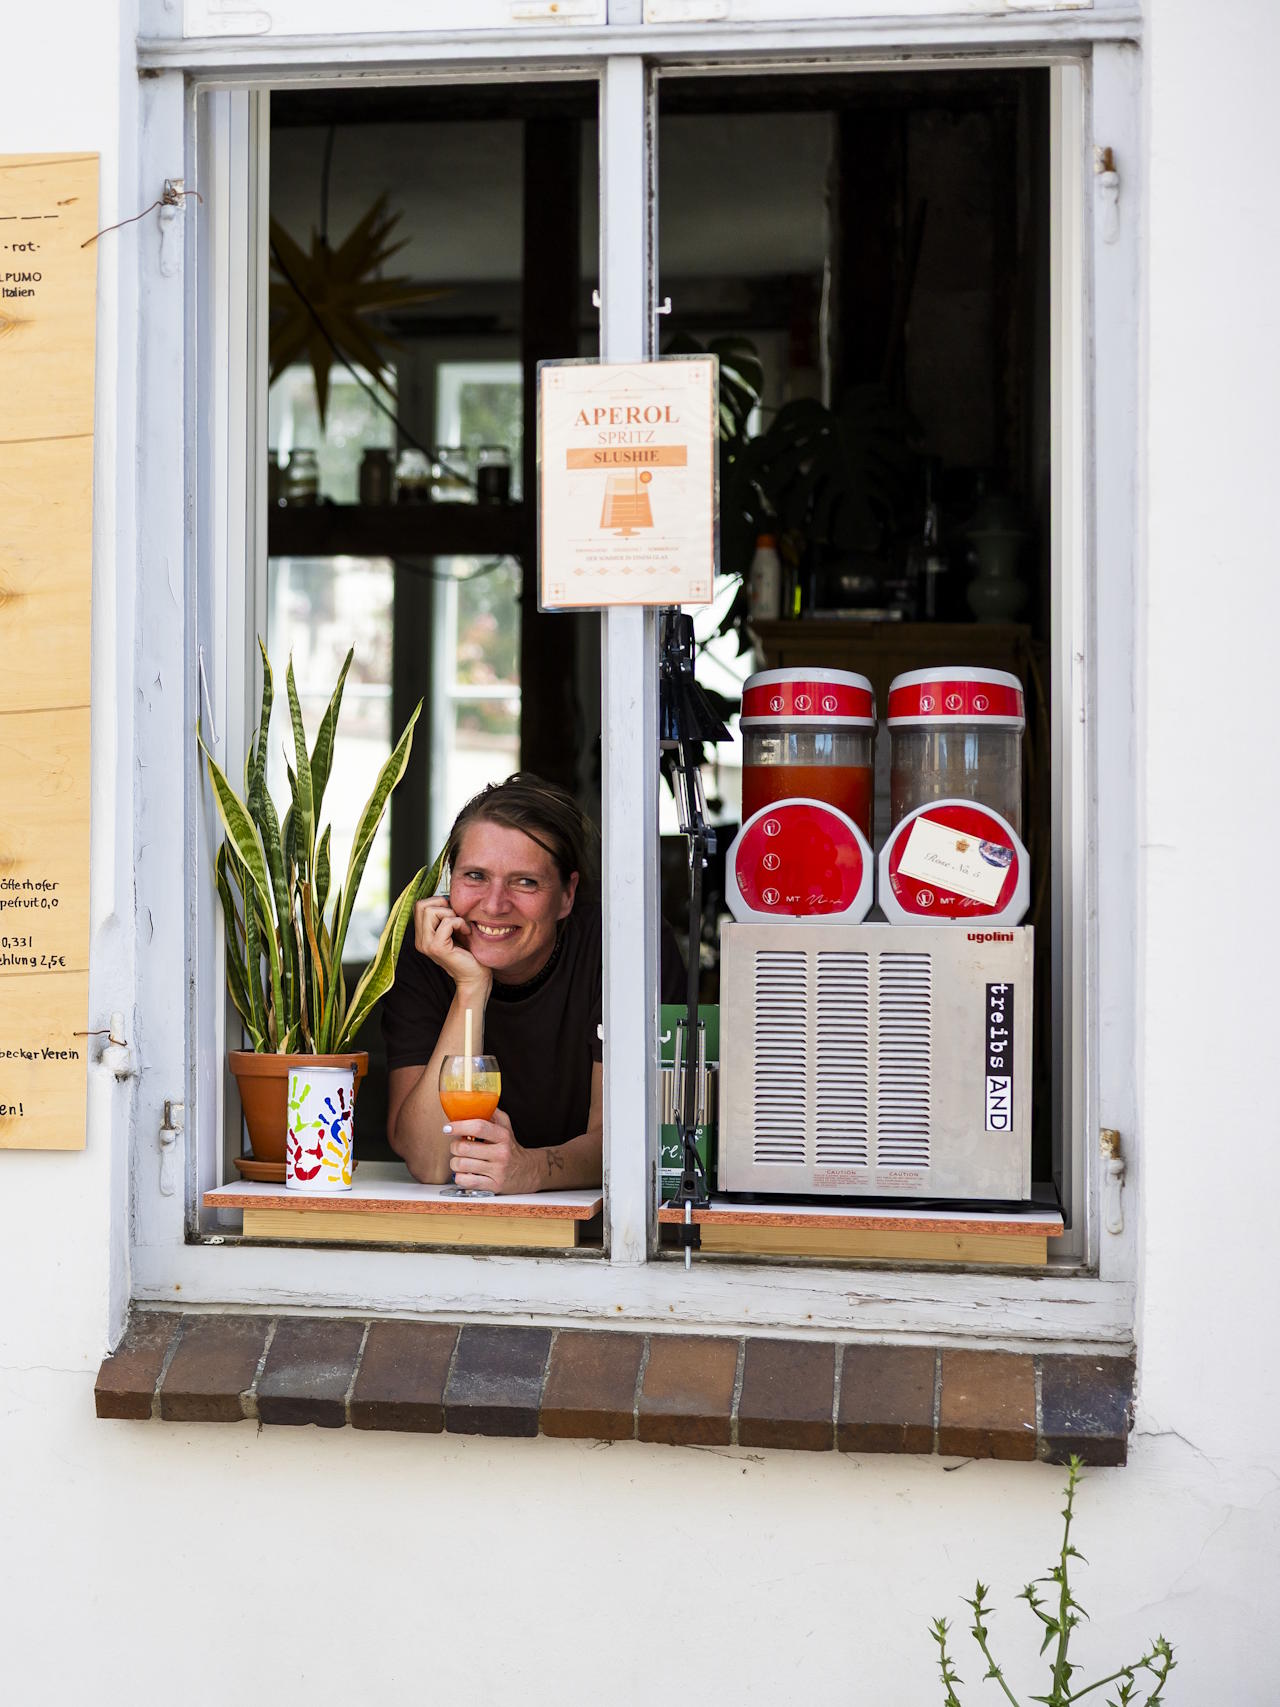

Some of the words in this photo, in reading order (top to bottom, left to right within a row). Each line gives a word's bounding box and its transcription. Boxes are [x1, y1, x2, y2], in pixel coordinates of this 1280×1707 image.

[3, 271, 42, 283] PUMO
[2, 287, 35, 299] Italien
[574, 405, 680, 426] APEROL
[598, 430, 655, 444] SPRITZ
[593, 450, 660, 463] SLUSHIE
[40, 897, 59, 910] 0,0
[967, 932, 1014, 943] ugolini
[40, 954, 66, 970] 2,5€
[989, 984, 1009, 1069] treibs
[41, 1048, 79, 1060] Verein
[989, 1079, 1008, 1130] AND
